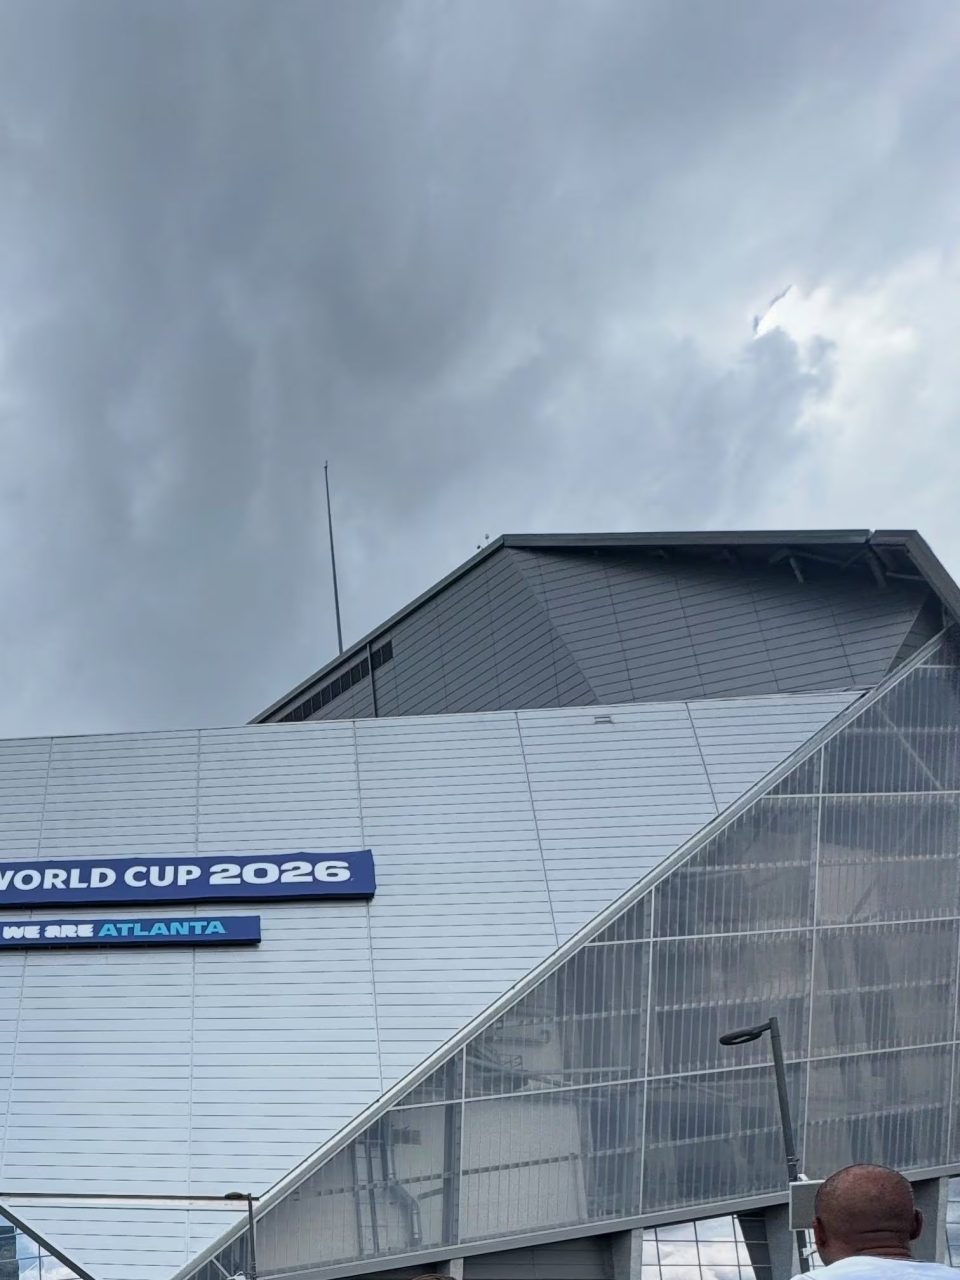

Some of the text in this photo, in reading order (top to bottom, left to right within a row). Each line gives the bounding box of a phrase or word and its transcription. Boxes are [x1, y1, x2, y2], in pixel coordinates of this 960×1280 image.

[123, 865, 202, 888] CUP
[208, 860, 351, 885] 2026
[2, 920, 227, 940] WE ARE ATLANTA
